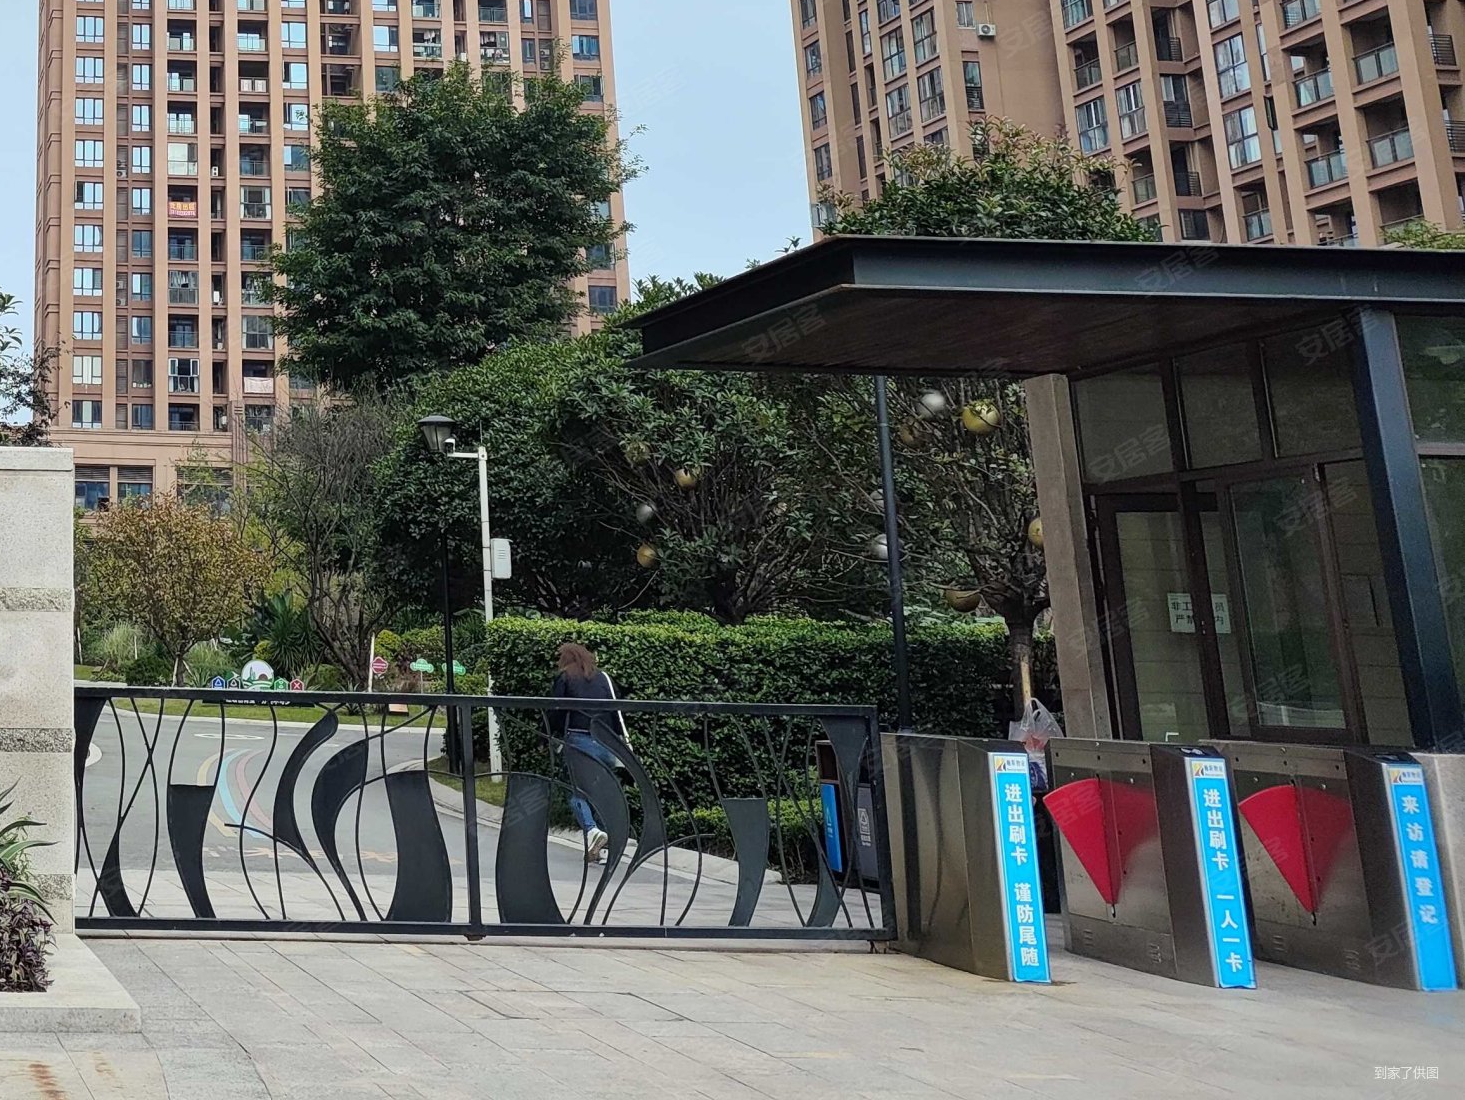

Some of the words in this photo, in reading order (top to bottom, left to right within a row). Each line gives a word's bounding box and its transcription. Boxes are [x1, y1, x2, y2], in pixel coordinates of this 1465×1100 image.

[1004, 784, 1029, 866] 进出刷卡
[1401, 795, 1438, 925] 来访请登记
[1014, 883, 1040, 967] 谨防尾随
[1203, 788, 1229, 871] 进出刷卡
[1216, 894, 1243, 973] 一人一卡
